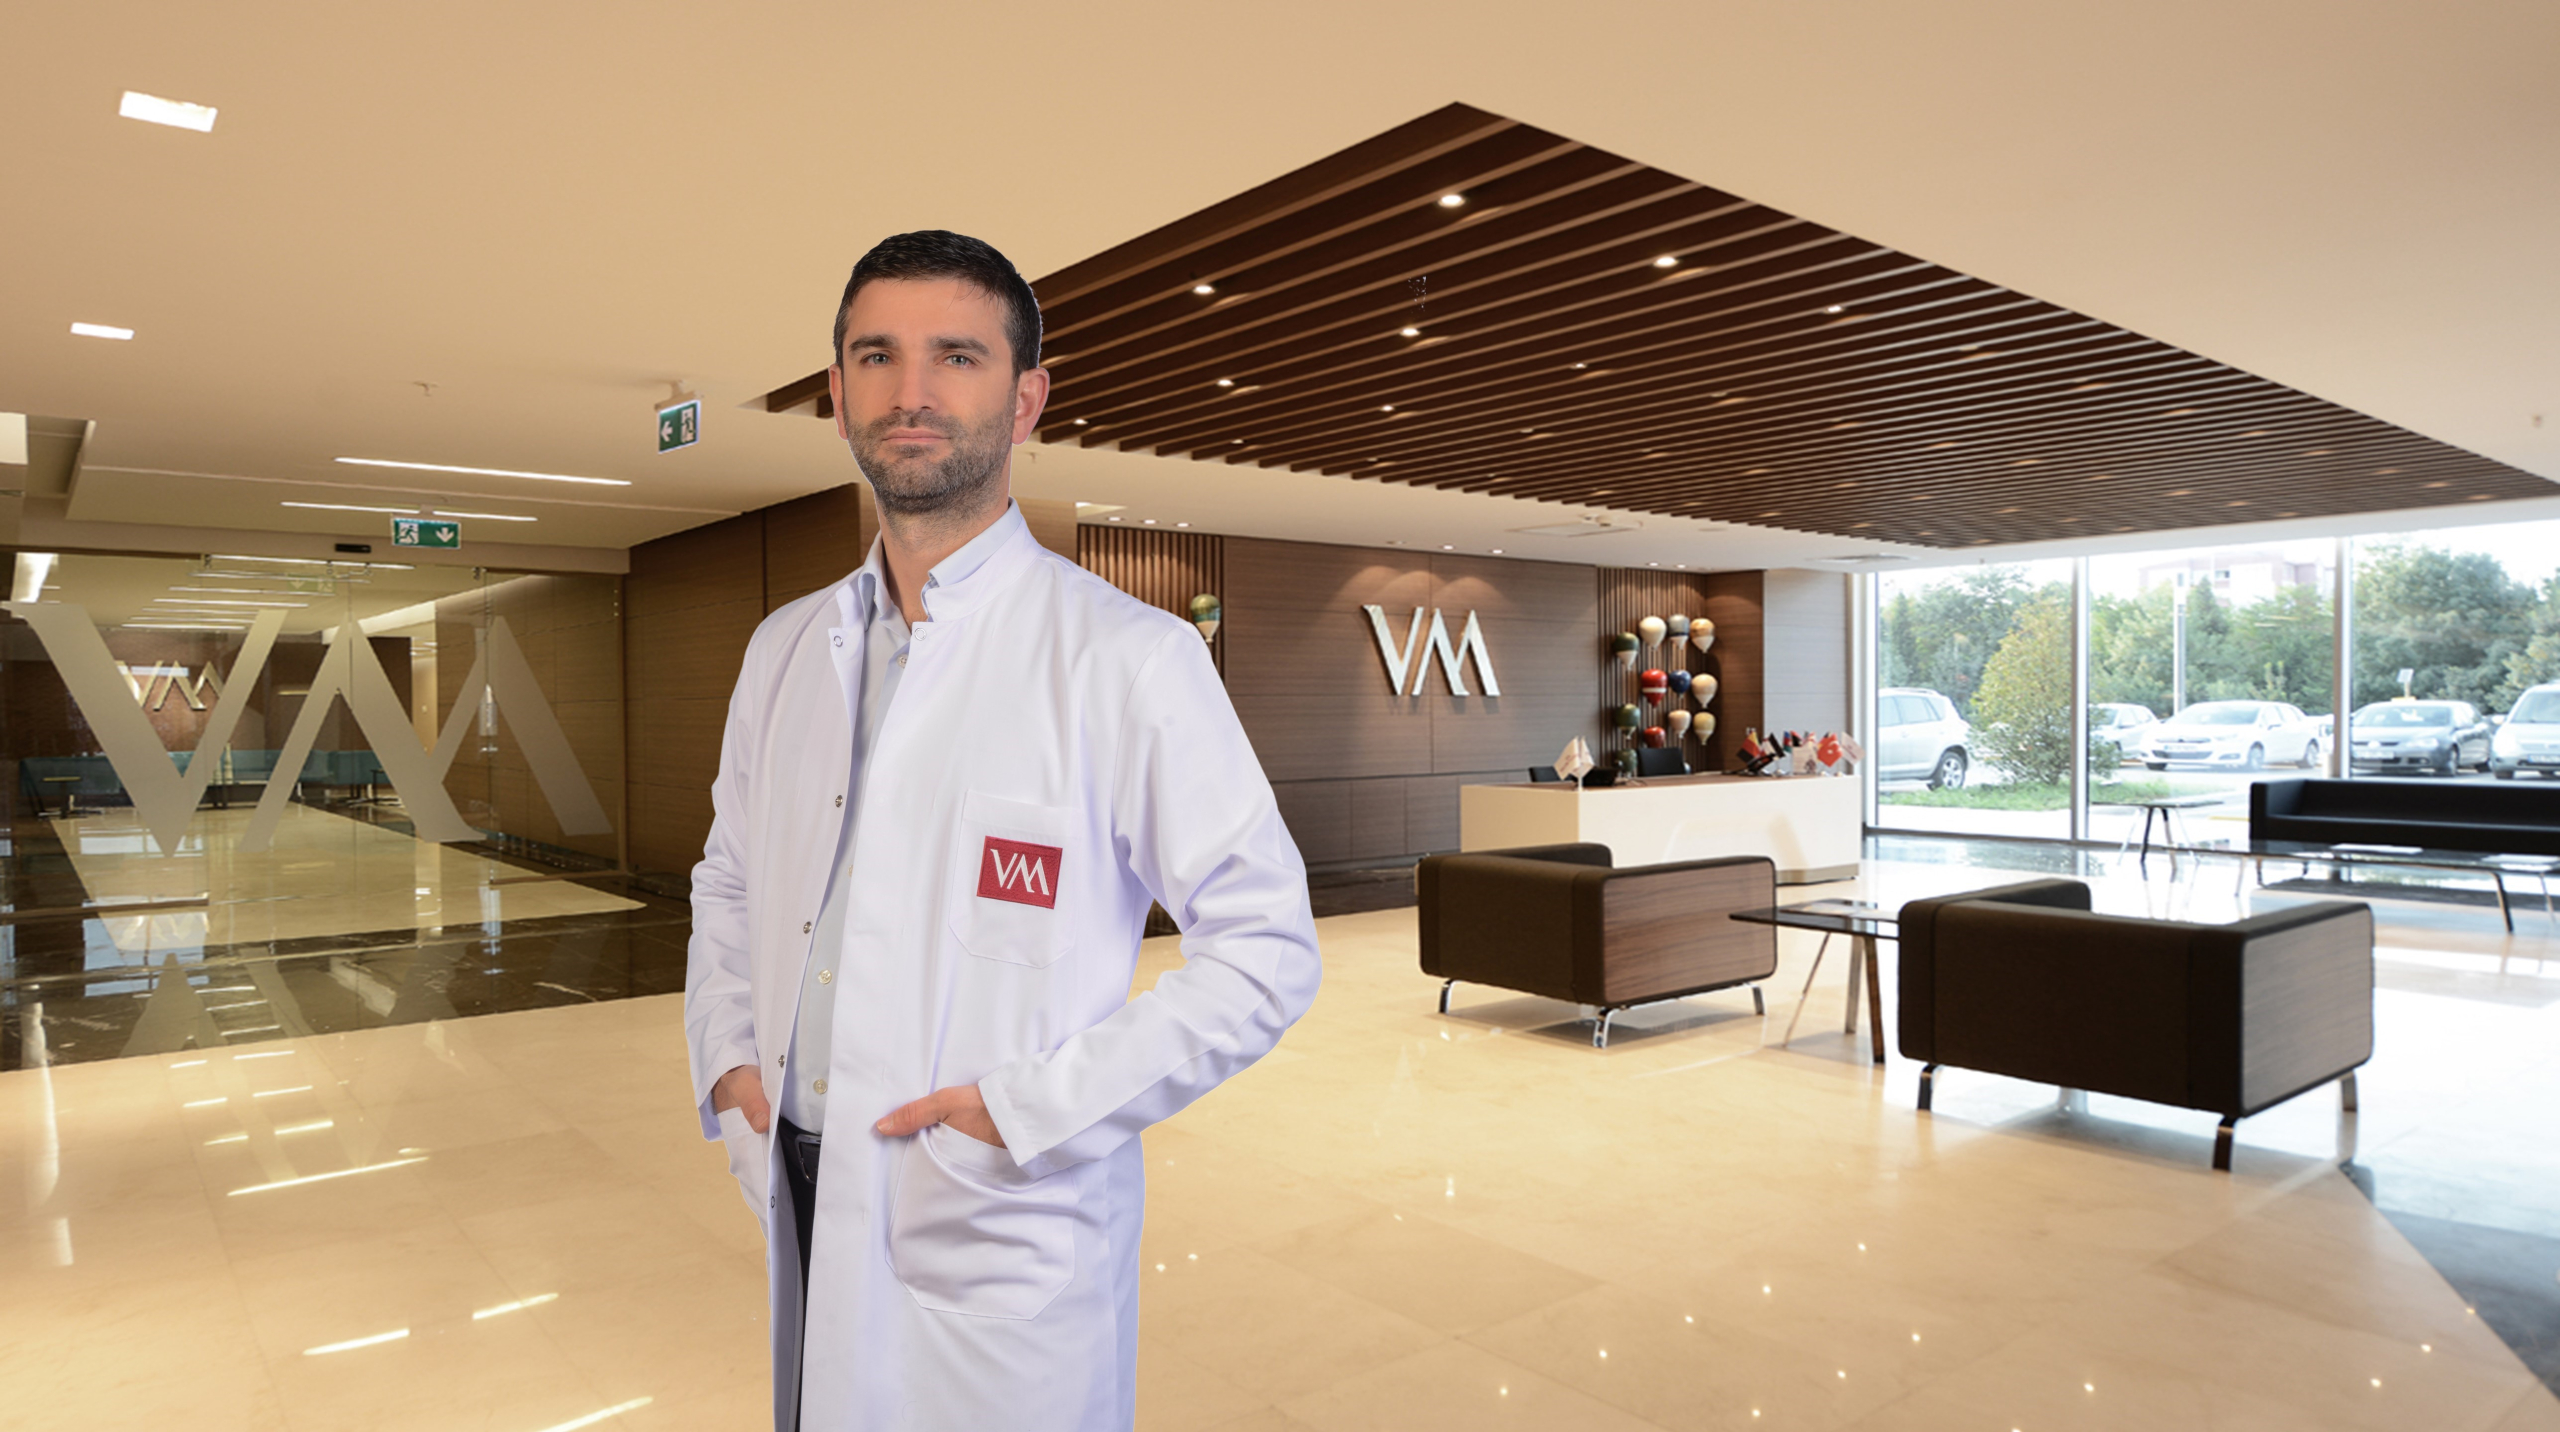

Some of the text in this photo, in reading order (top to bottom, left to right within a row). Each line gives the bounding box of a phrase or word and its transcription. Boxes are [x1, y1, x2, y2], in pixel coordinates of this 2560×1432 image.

[1362, 604, 1501, 696] VM
[0, 601, 614, 858] VM
[990, 848, 1050, 896] VM
